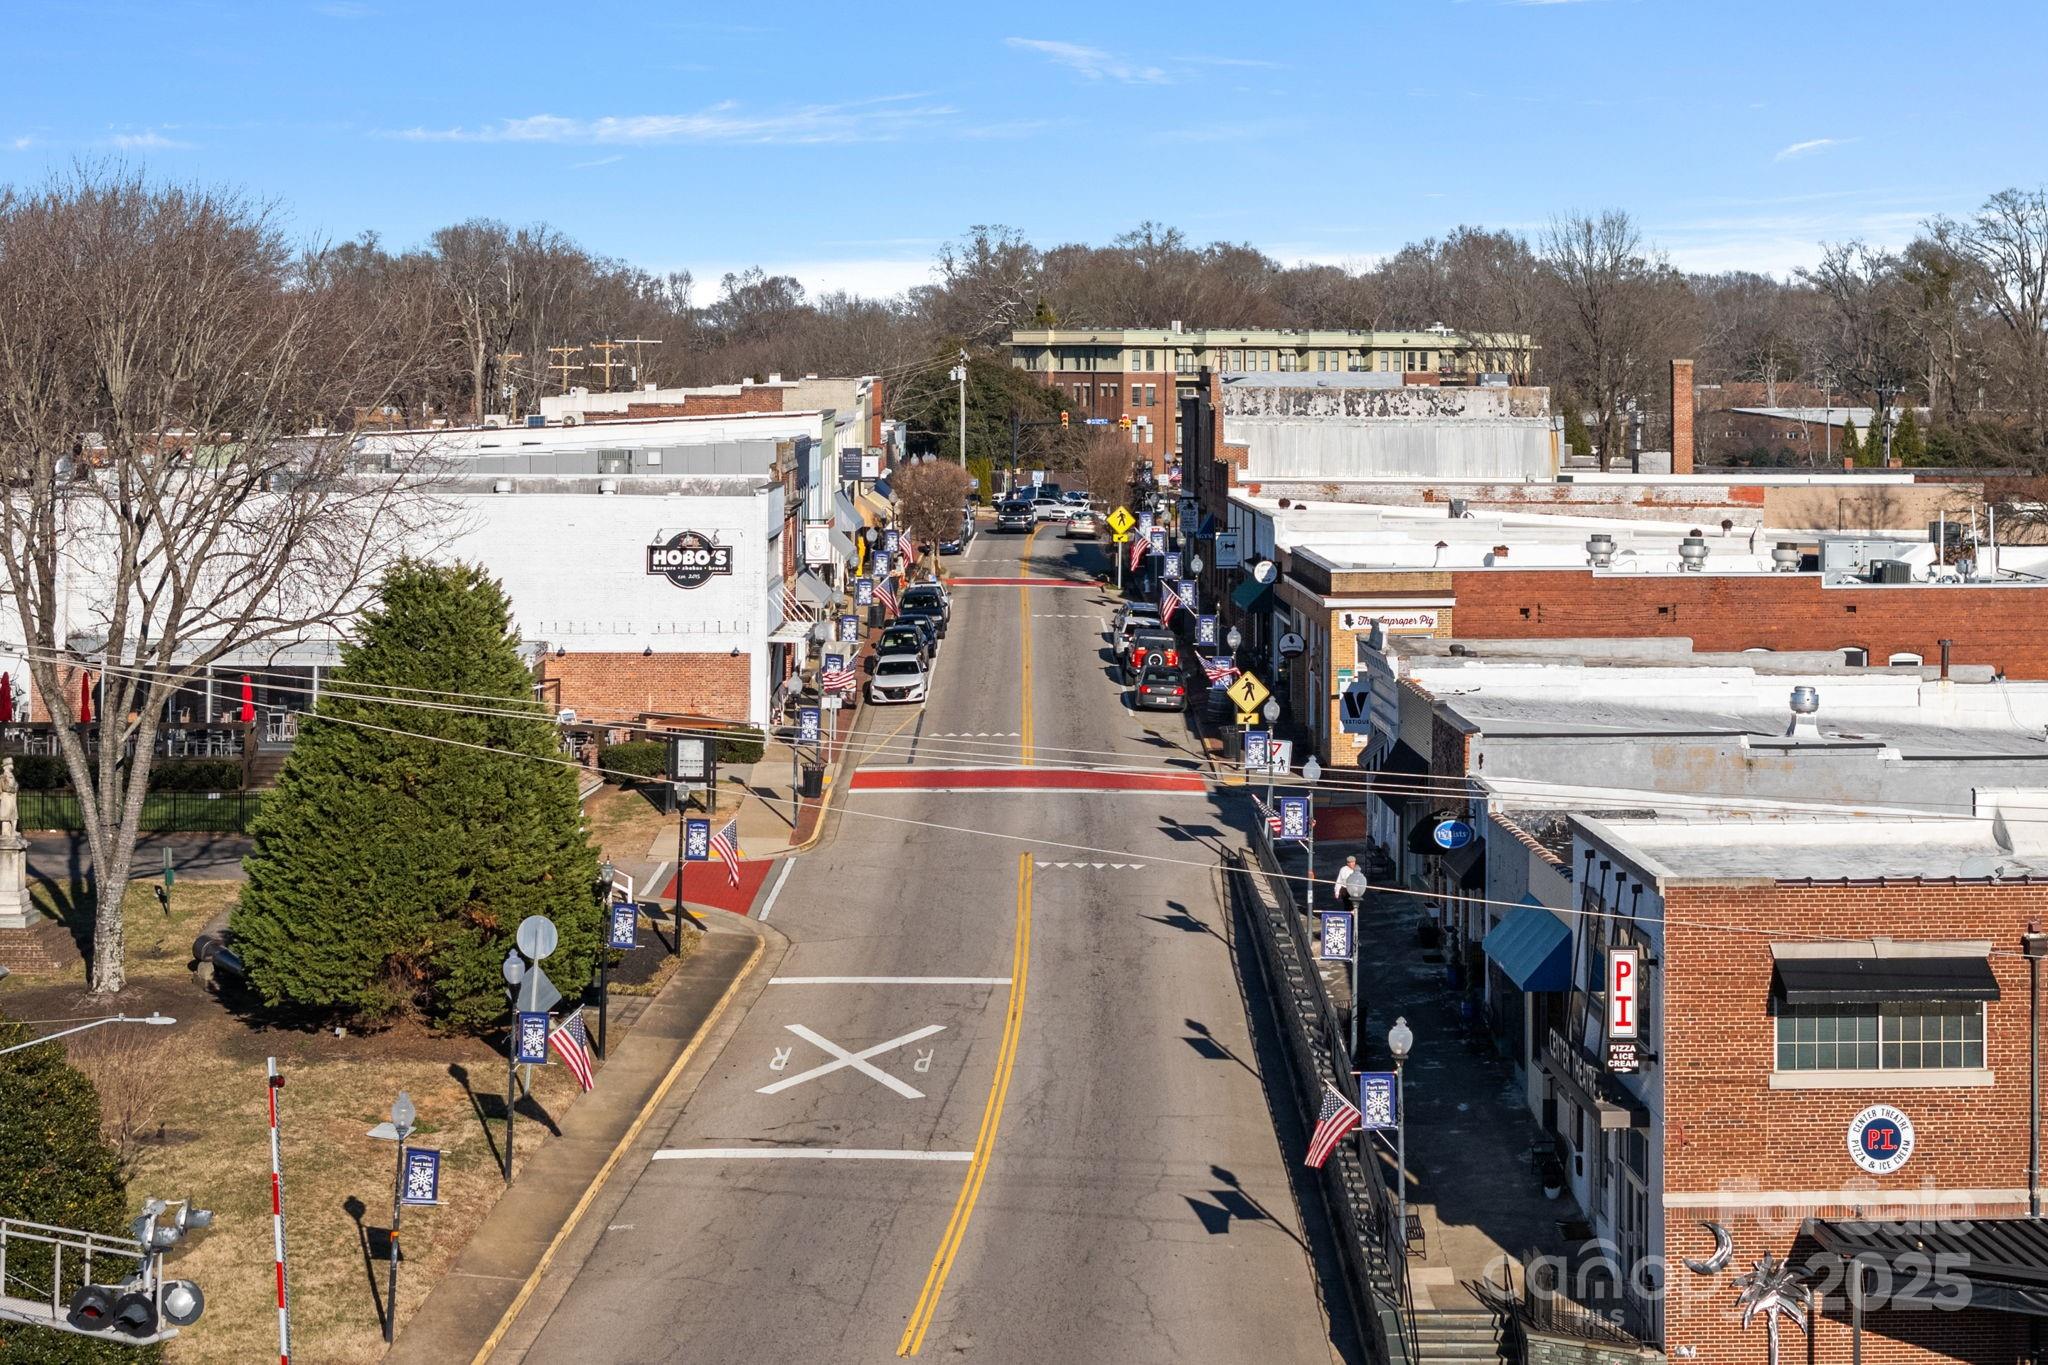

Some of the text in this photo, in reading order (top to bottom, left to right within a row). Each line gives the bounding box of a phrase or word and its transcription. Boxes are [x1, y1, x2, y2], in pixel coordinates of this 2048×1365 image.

[653, 550, 727, 565] HOBO'S
[1357, 615, 1371, 625] Th
[1419, 615, 1434, 627] Pig
[1610, 1044, 1636, 1052] PIZZA
[1549, 1026, 1599, 1100] CENTER THEATRE
[1853, 1108, 1910, 1133] CENTER THEATRE
[1851, 1139, 1911, 1170] PIZZA & ICE CREAM
